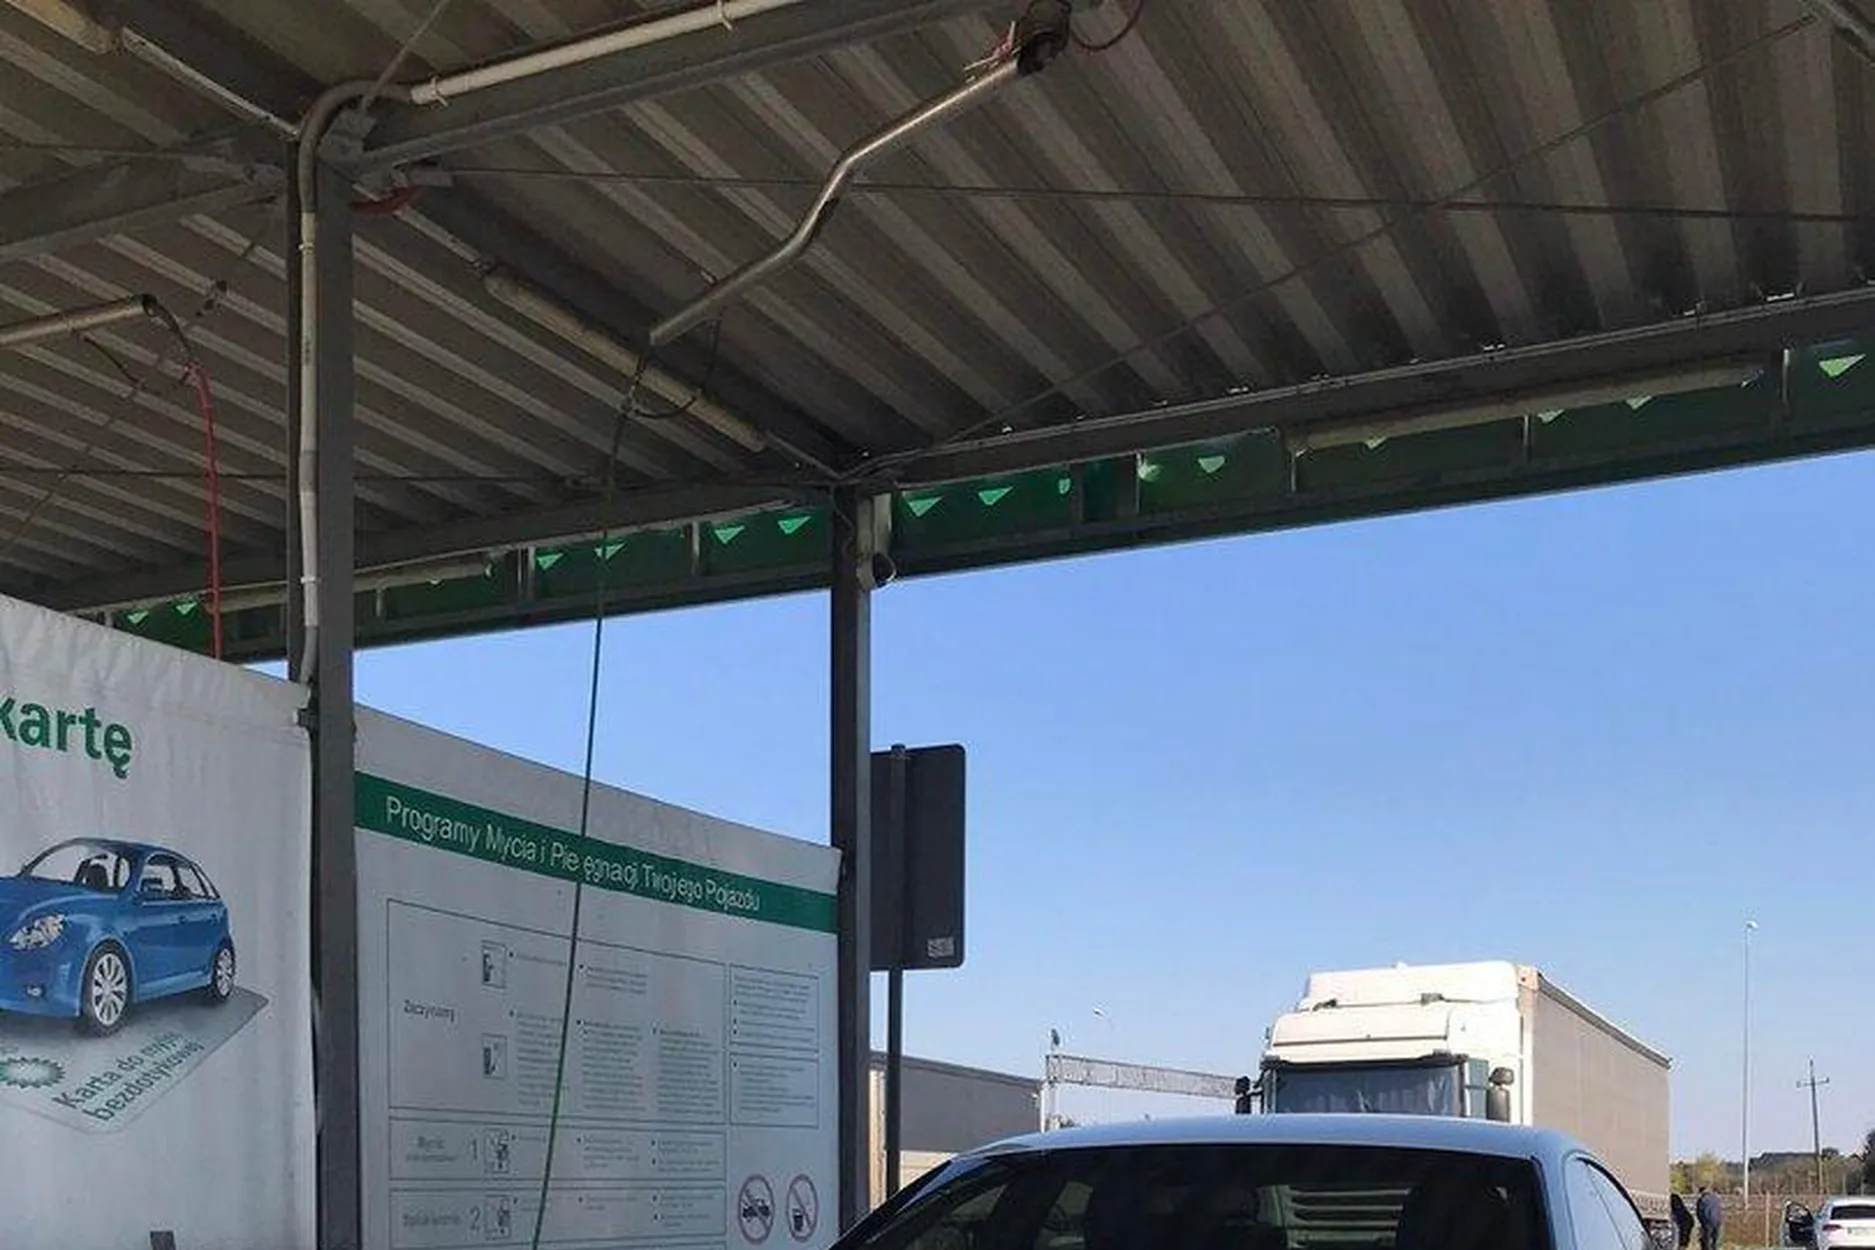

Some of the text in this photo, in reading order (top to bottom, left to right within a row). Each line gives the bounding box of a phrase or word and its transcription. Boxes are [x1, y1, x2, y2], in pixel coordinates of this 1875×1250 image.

[386, 796, 481, 851] Programy
[485, 824, 537, 861] Mycia
[642, 864, 703, 903] Twojego
[705, 879, 760, 910] Pojazdu
[52, 1070, 122, 1109] Karta
[115, 1054, 144, 1072] do
[469, 1205, 481, 1231] 2
